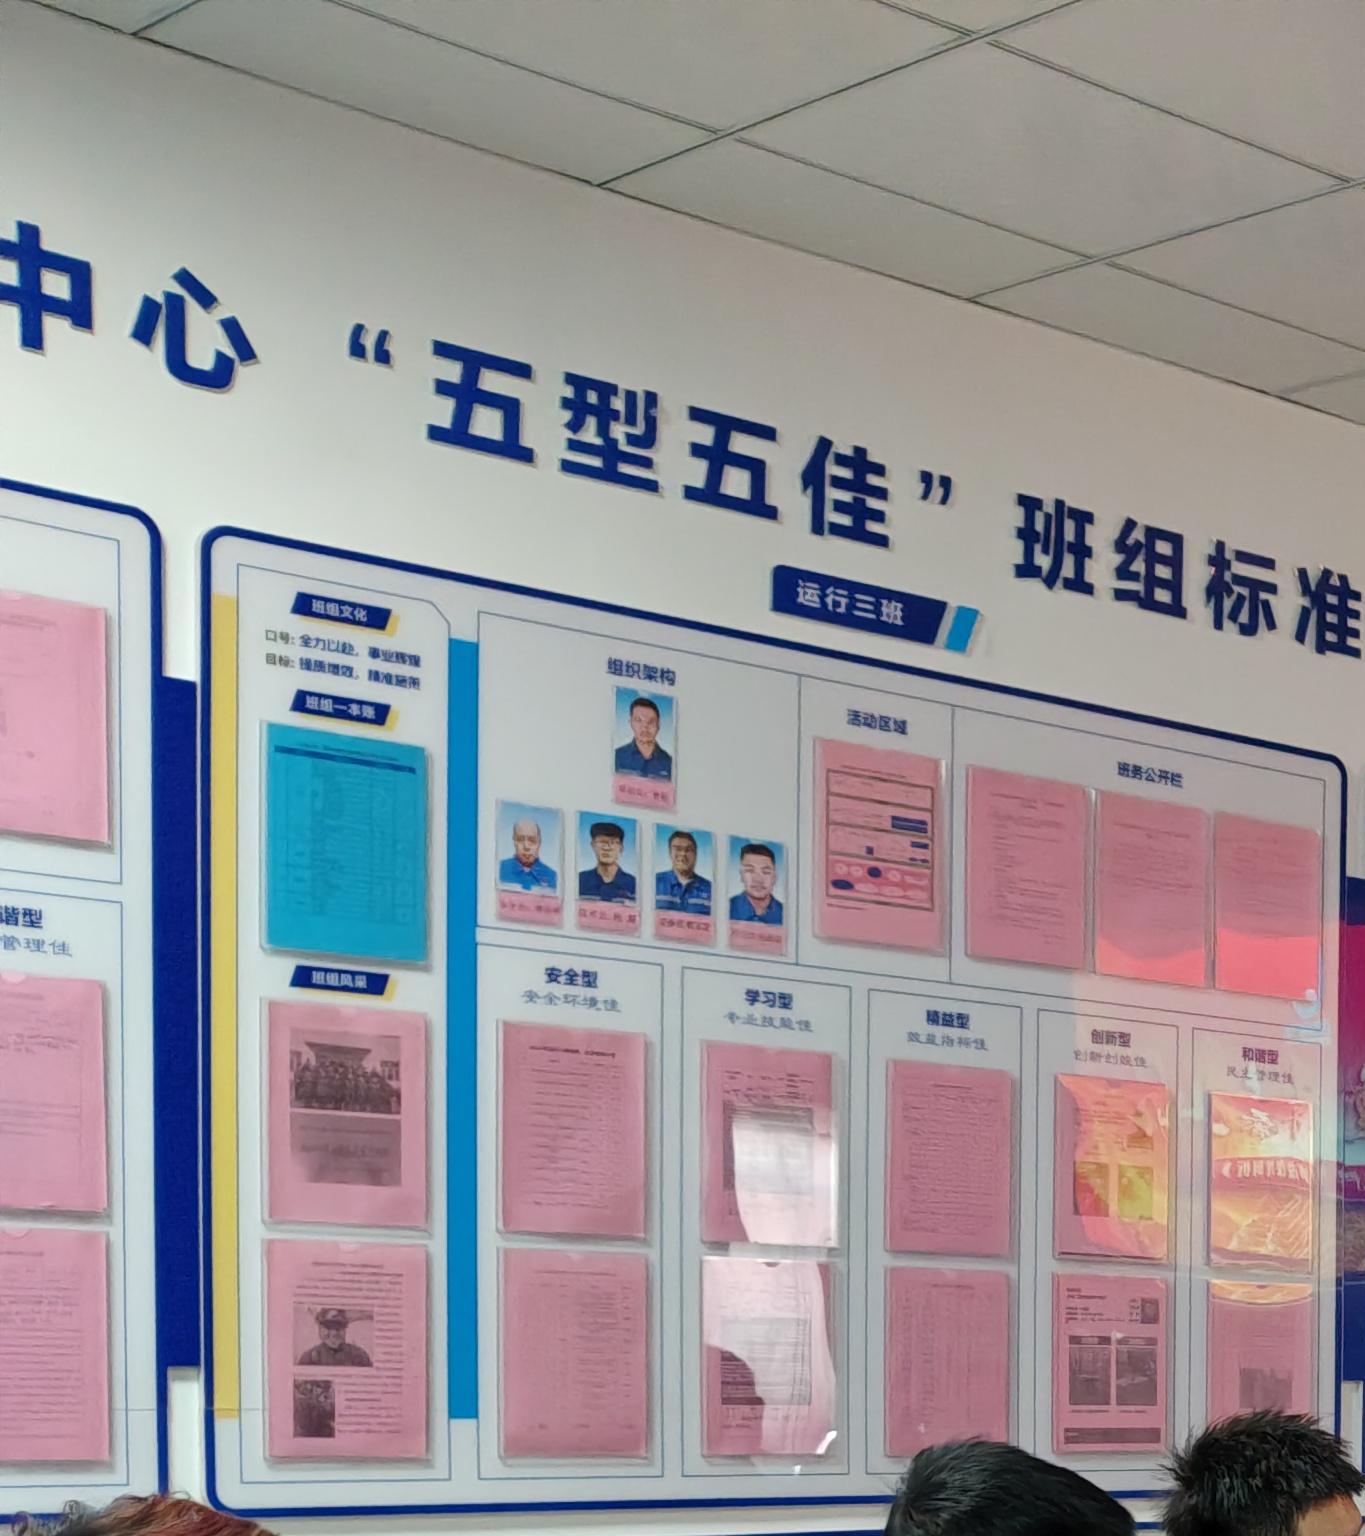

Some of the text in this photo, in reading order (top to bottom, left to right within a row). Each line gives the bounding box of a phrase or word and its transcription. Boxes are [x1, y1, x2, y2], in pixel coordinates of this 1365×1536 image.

[0, 220, 258, 392] 中心
[311, 599, 368, 622] 班组文化
[796, 578, 905, 626] 运行三班
[607, 658, 676, 687] 组织架构
[847, 708, 909, 736] 活动区域
[1117, 760, 1184, 789] 班务公开栏
[0, 934, 73, 957] 管理佳
[544, 966, 599, 989] 安全型
[520, 990, 622, 1013] 安全环境佳
[744, 988, 794, 1010] 学习型
[926, 1009, 971, 1030] 精益型
[1090, 1028, 1131, 1048] 创新型
[1241, 1047, 1280, 1066] 和谐型
